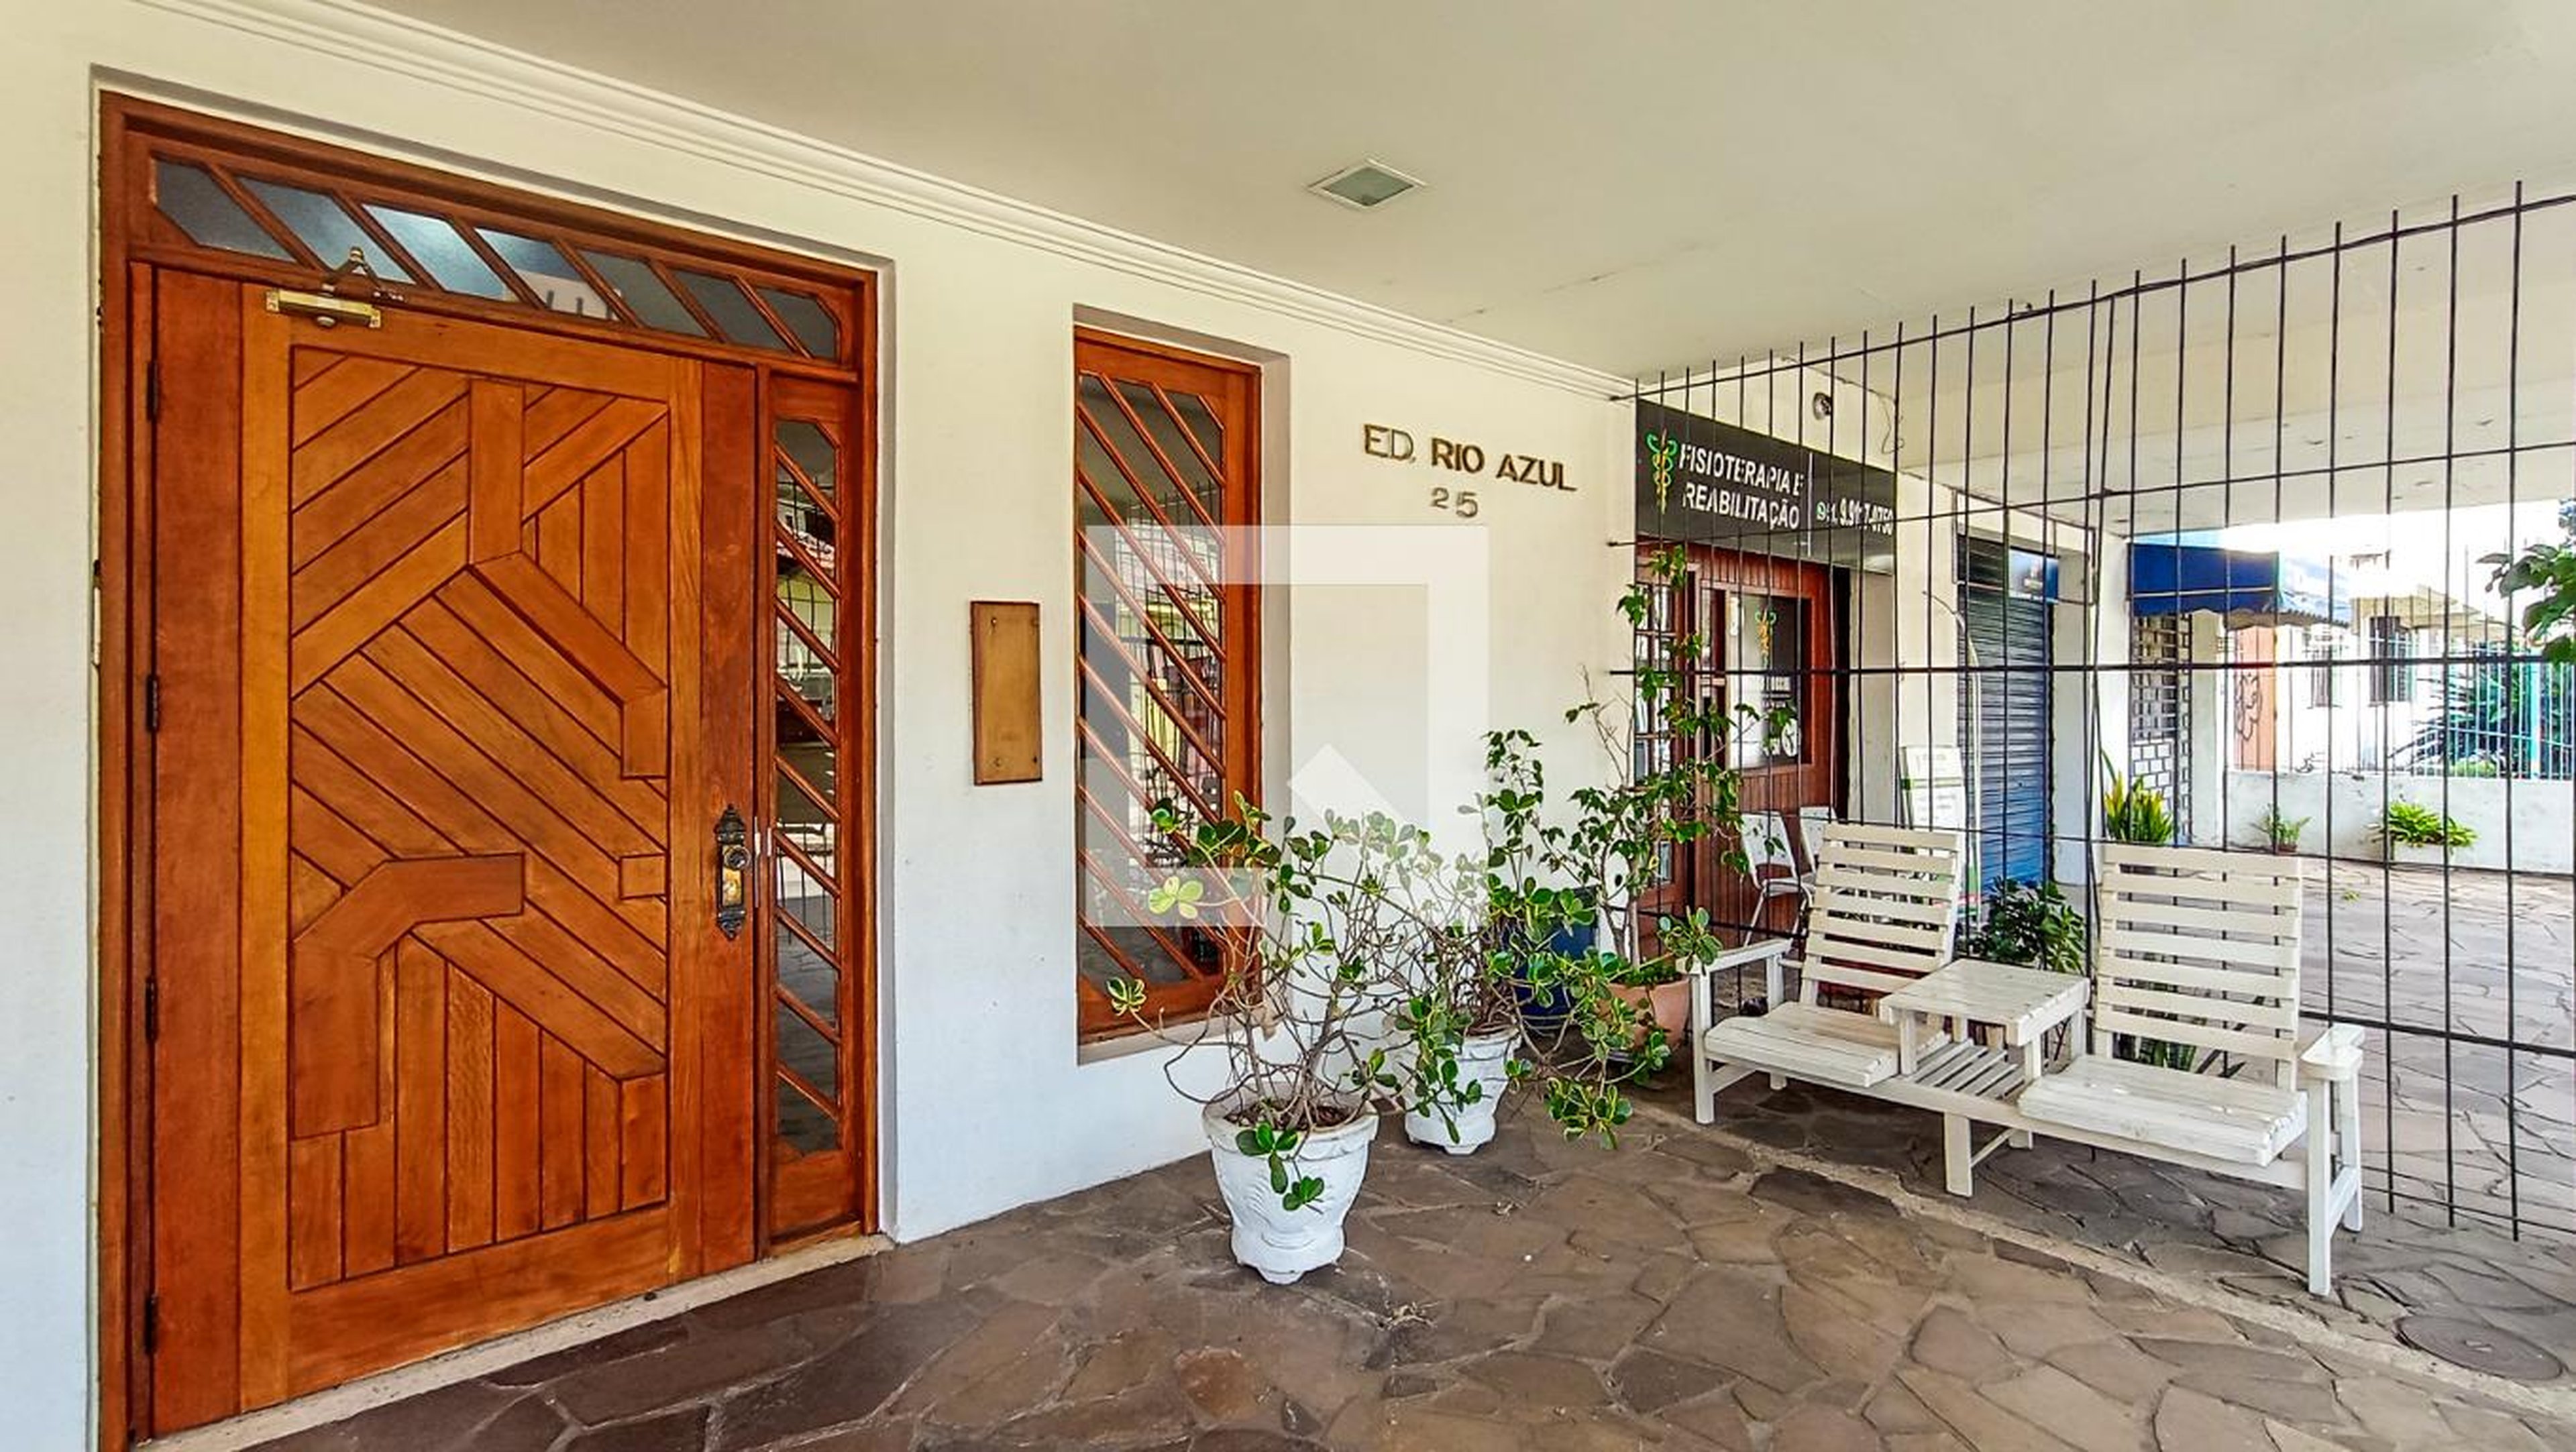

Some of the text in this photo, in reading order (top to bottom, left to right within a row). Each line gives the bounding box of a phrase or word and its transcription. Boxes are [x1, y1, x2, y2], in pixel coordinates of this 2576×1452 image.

[1431, 437, 1485, 473] RIO
[1495, 453, 1578, 492] AZUL
[1678, 443, 1805, 496] FISIOTERAPIA E
[1430, 486, 1479, 518] 25
[1682, 482, 1800, 530] REABILITAÇÃO
